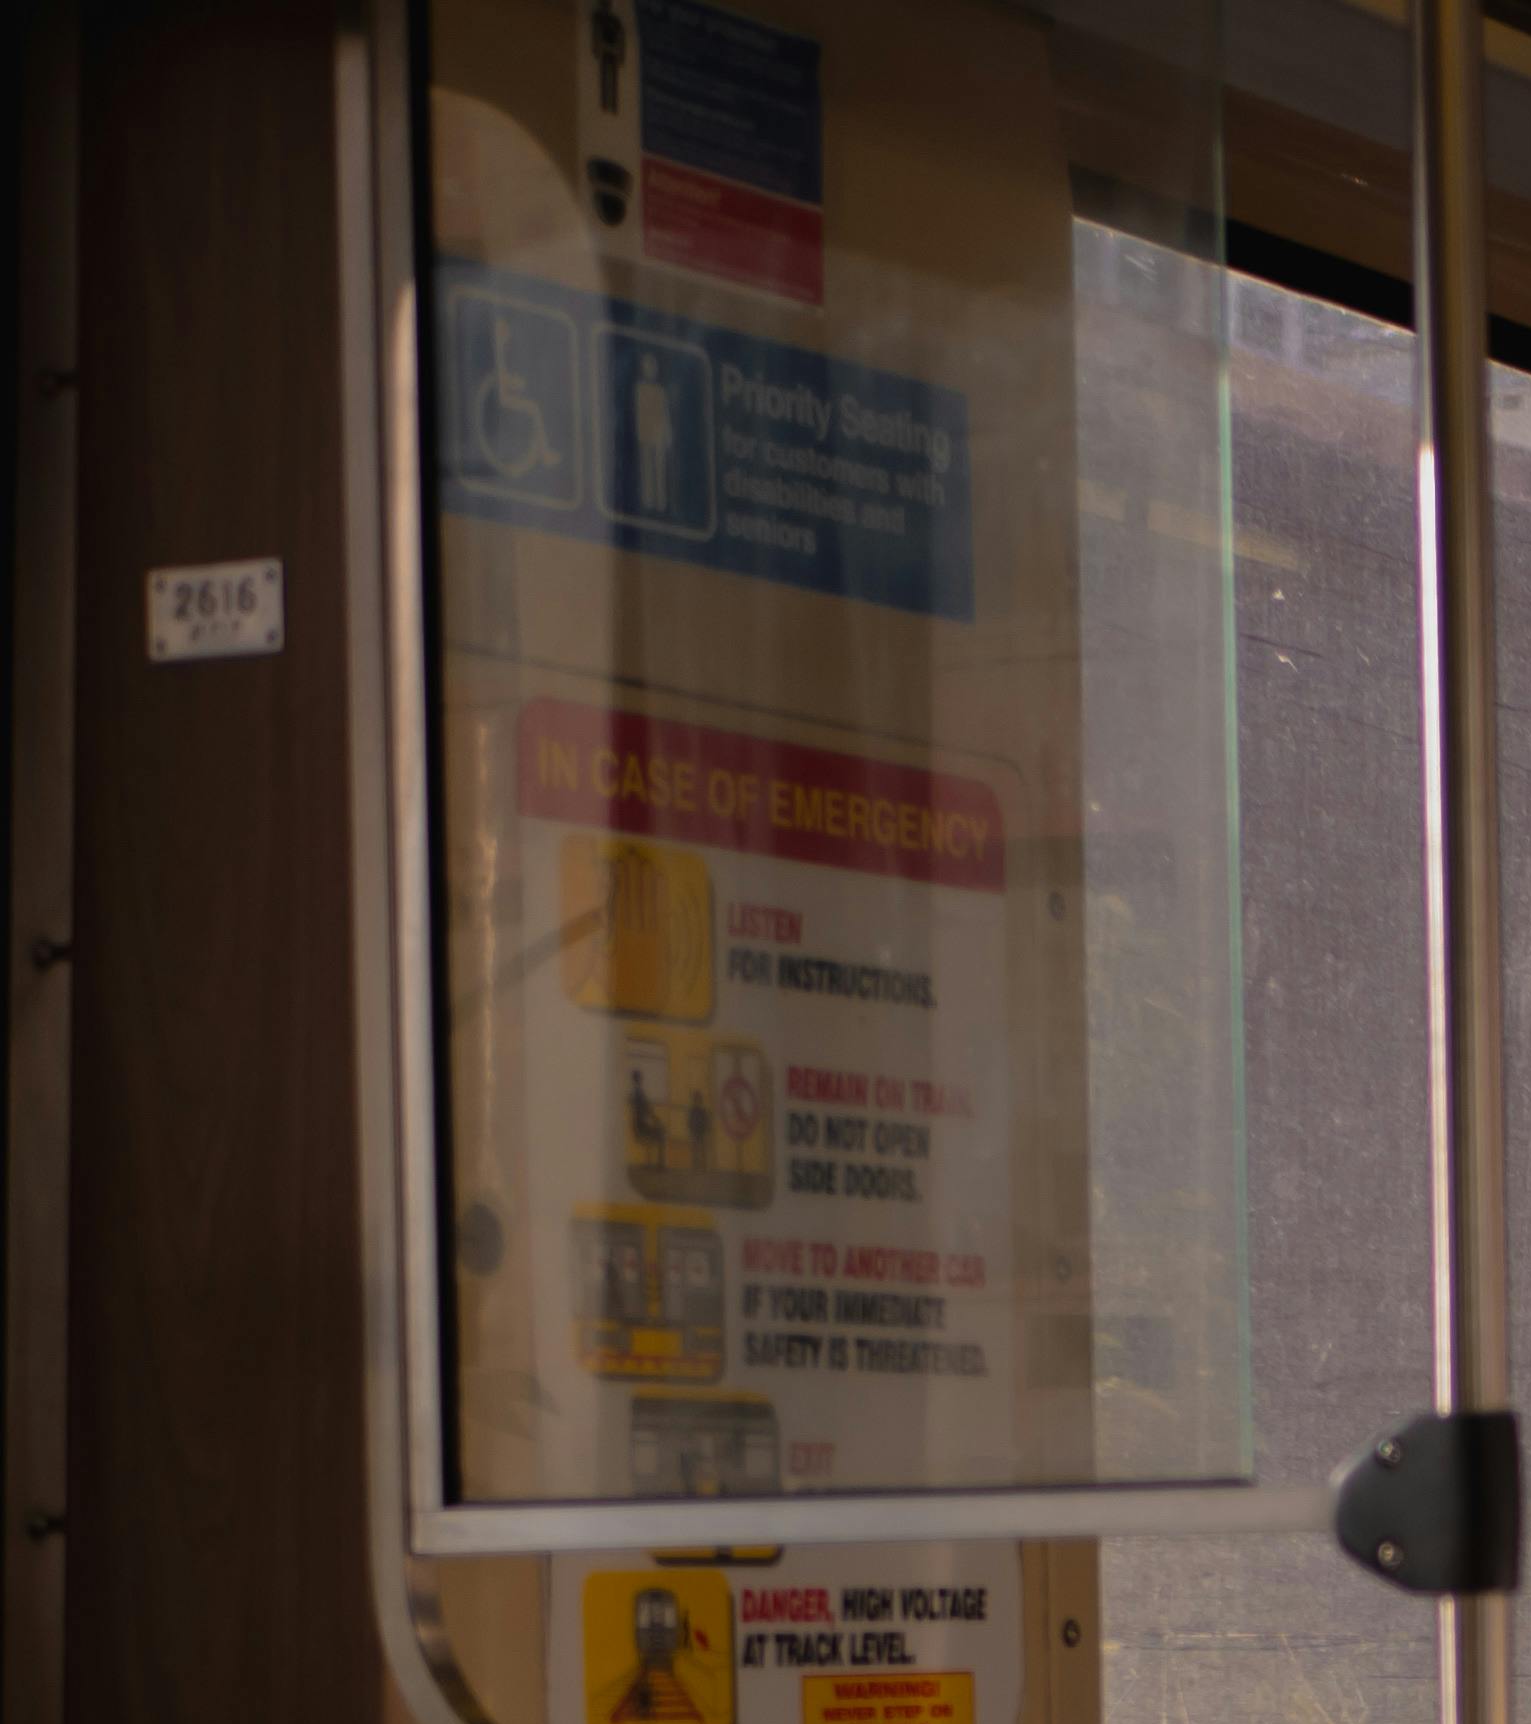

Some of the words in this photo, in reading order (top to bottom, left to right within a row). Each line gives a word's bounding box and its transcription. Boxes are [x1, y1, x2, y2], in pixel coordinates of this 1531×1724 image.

[719, 361, 832, 442] Priority
[838, 394, 951, 475] Seating
[721, 424, 757, 460] for
[763, 440, 891, 494] customers
[722, 467, 857, 525] disabilities
[725, 511, 818, 555] seniors
[173, 574, 259, 622] 2616
[537, 737, 578, 791] IN
[590, 749, 698, 813] CASE
[708, 769, 759, 820] OF
[769, 780, 990, 862] EMERGENCY
[727, 902, 804, 944] LISTEN
[728, 946, 772, 987] FOR
[788, 1064, 869, 1106] REMAIN
[788, 1112, 819, 1148] DO
[824, 1114, 868, 1154] NOT
[874, 1119, 931, 1160] OPEN
[789, 1156, 836, 1196] SIDE
[743, 1239, 802, 1275] MOVE
[808, 1242, 838, 1278] TO
[843, 1245, 941, 1285] ANOTHER
[743, 1284, 763, 1320] IF
[768, 1285, 829, 1323] YOUR
[743, 1331, 823, 1369] SAFETY
[829, 1335, 849, 1371] IS
[843, 1587, 894, 1622] HIGH
[900, 1586, 988, 1622] VOLTAGE
[742, 1634, 771, 1668] AT
[776, 1634, 843, 1667] TRACK
[850, 1632, 916, 1665] LEVEL.
